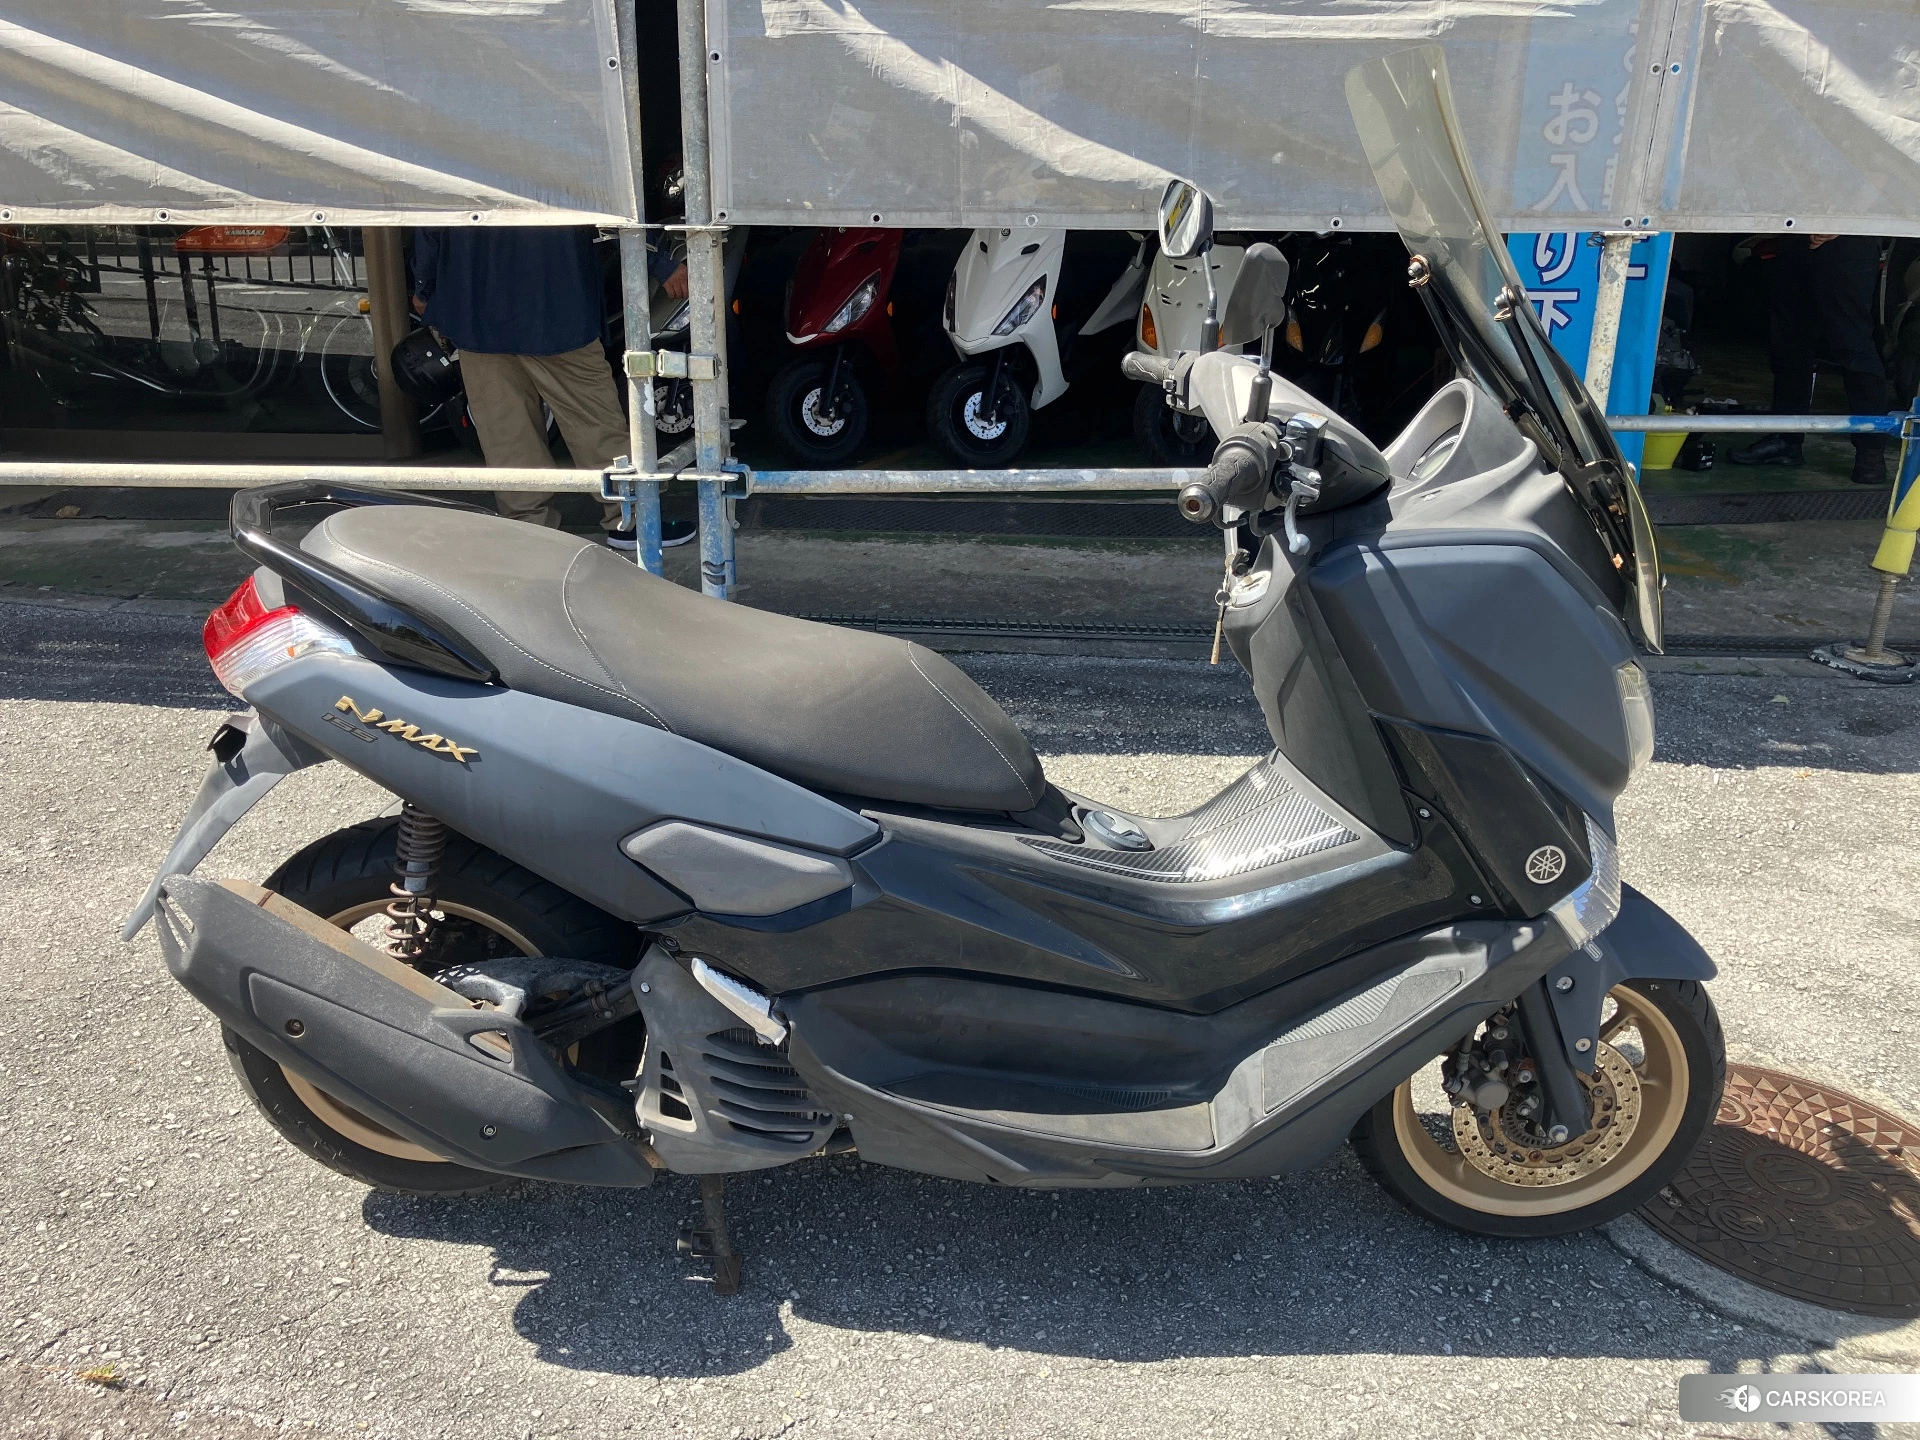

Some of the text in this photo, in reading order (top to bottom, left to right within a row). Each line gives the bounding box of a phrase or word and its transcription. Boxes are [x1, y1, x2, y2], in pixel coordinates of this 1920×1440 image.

[225, 228, 265, 237] KAWASAKI
[321, 712, 379, 744] 155
[334, 695, 479, 763] NMAX
